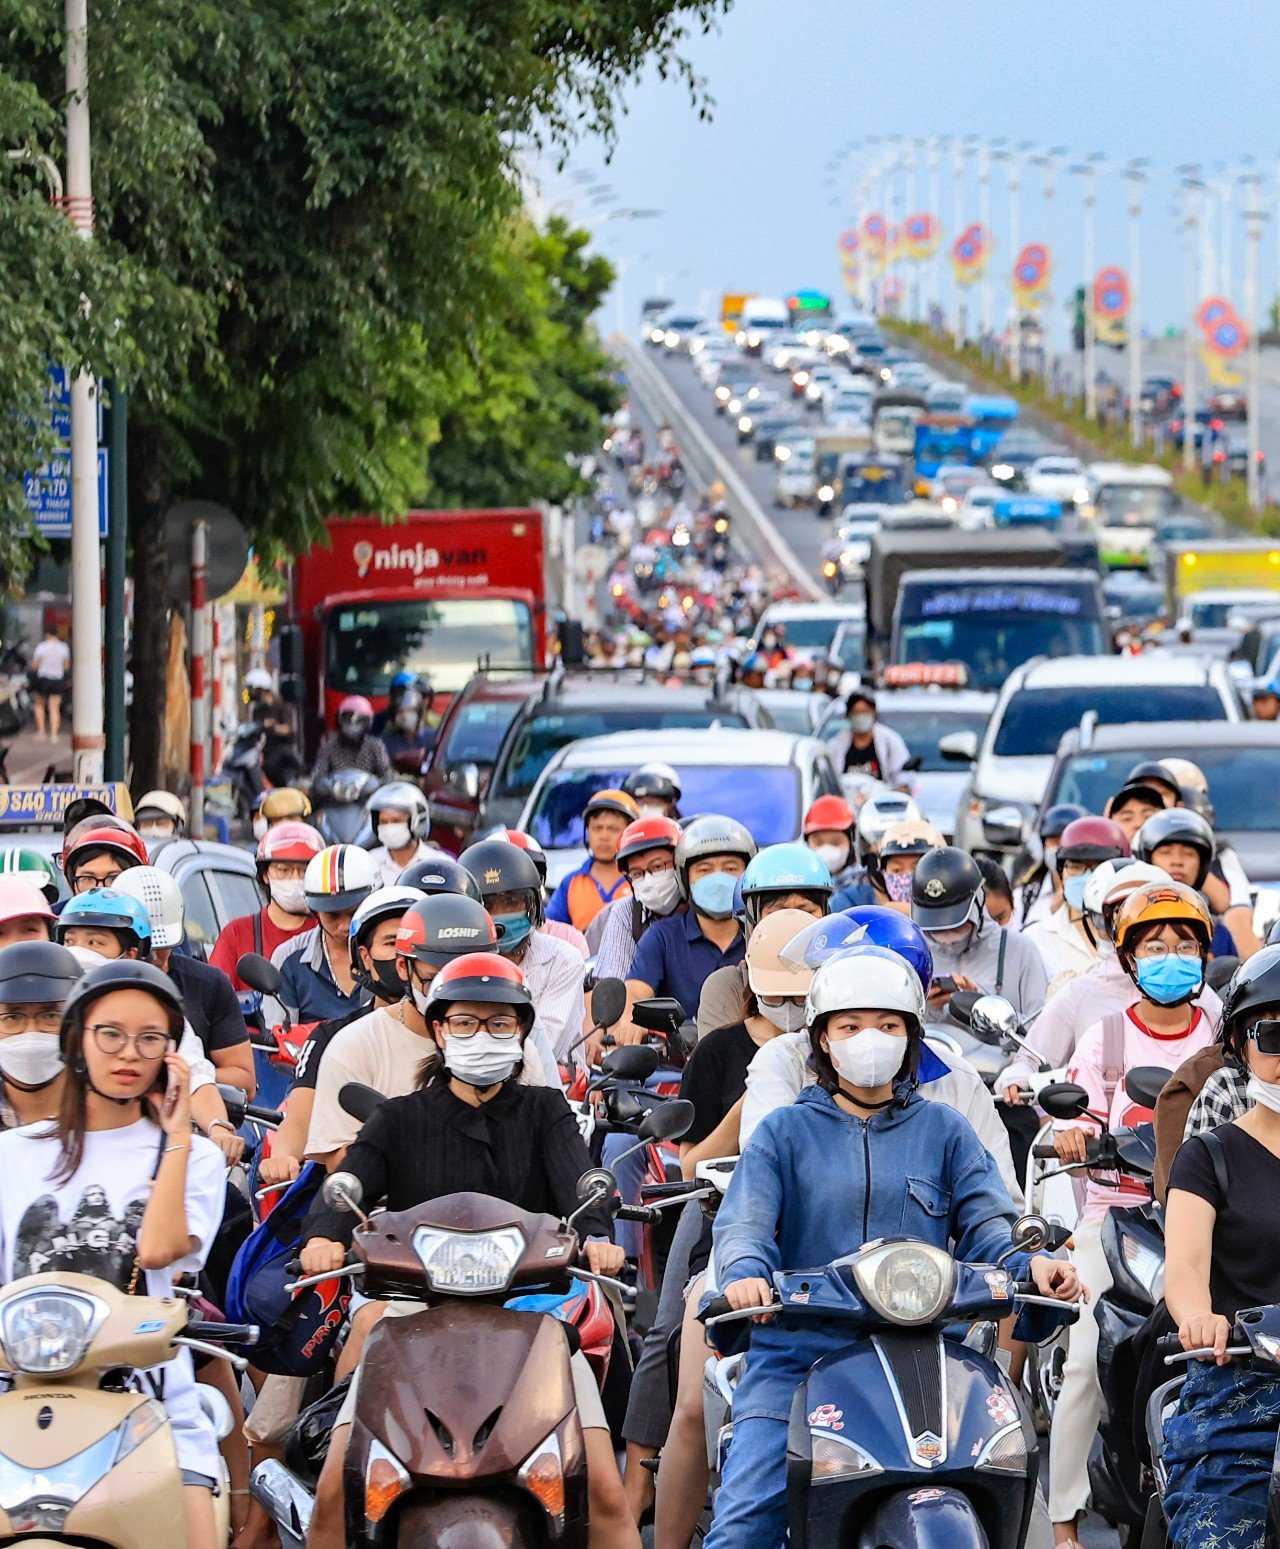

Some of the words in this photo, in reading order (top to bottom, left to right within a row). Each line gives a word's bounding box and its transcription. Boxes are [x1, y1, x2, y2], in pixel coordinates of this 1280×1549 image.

[10, 791, 46, 812] SAO
[437, 927, 482, 939] LOSHIP
[22, 1392, 77, 1401] HONDA
